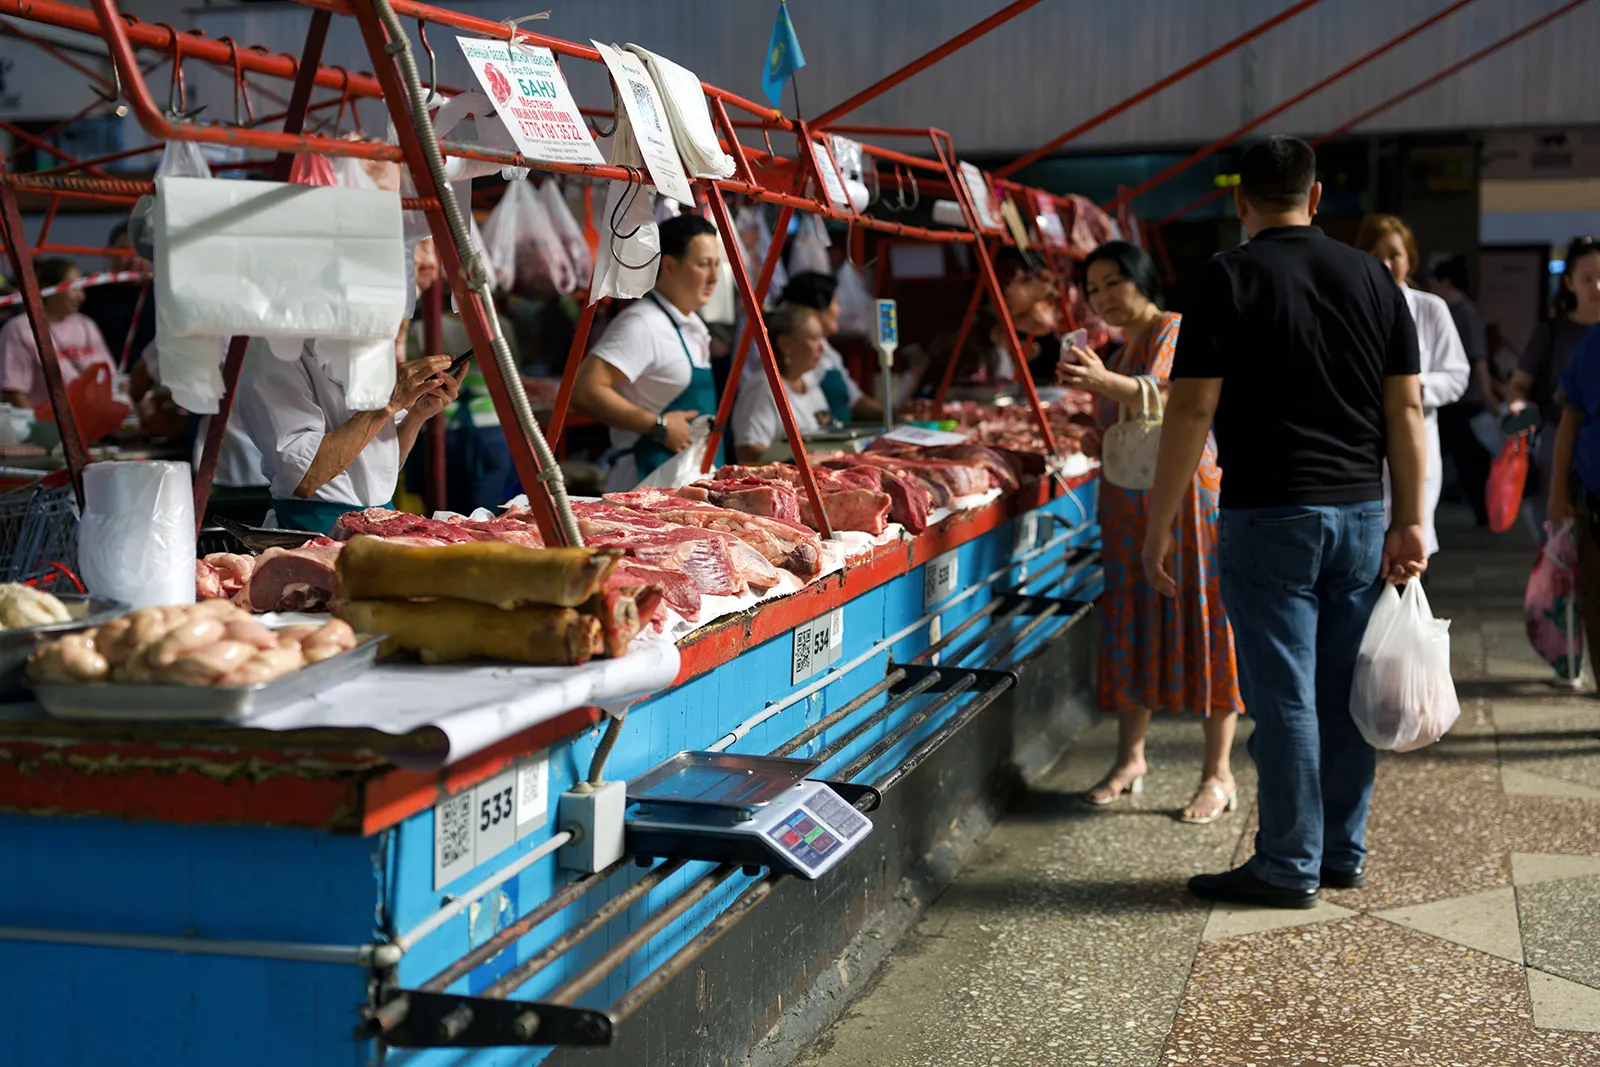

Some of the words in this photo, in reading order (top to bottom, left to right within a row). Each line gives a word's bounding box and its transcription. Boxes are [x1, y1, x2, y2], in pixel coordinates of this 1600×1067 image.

[534, 69, 552, 78] место
[518, 78, 557, 99] БАНУ
[518, 96, 554, 110] Местная
[518, 121, 529, 136] 8
[524, 121, 544, 138] 778
[542, 123, 560, 139] 191
[556, 124, 571, 140] 35
[568, 125, 583, 140] 22
[814, 627, 830, 655] 534
[480, 786, 513, 831] 533
